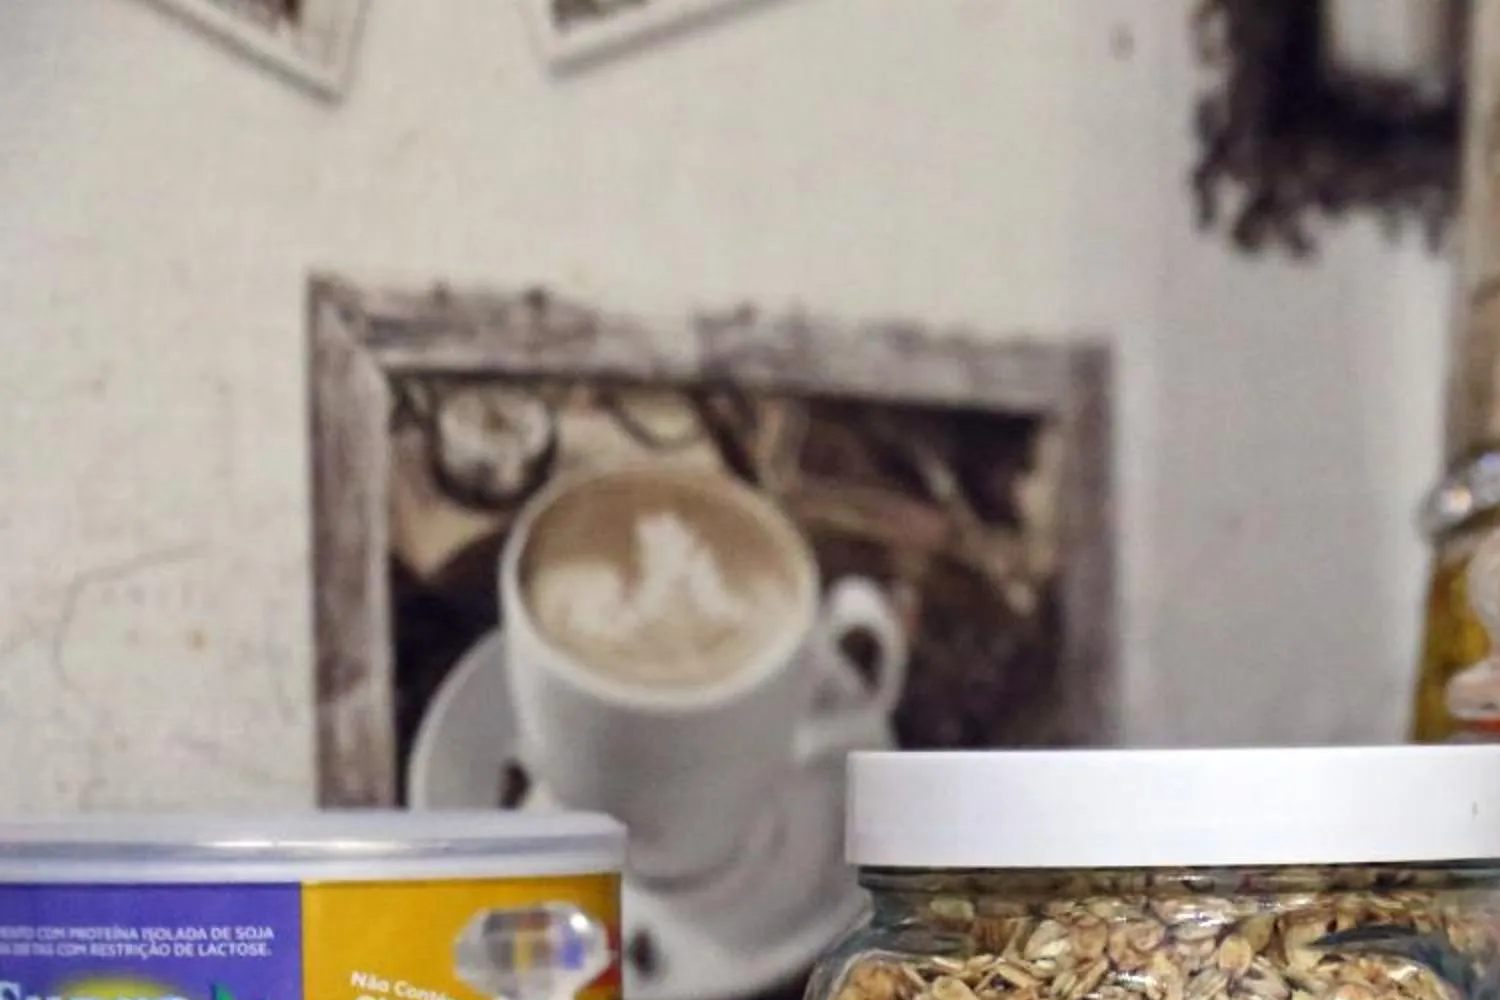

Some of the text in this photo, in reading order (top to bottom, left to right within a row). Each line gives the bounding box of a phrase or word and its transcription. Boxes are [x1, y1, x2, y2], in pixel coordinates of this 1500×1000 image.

[210, 926, 232, 941] DE
[235, 926, 275, 942] SOJA
[174, 943, 195, 957] DE
[350, 970, 390, 994] Não
